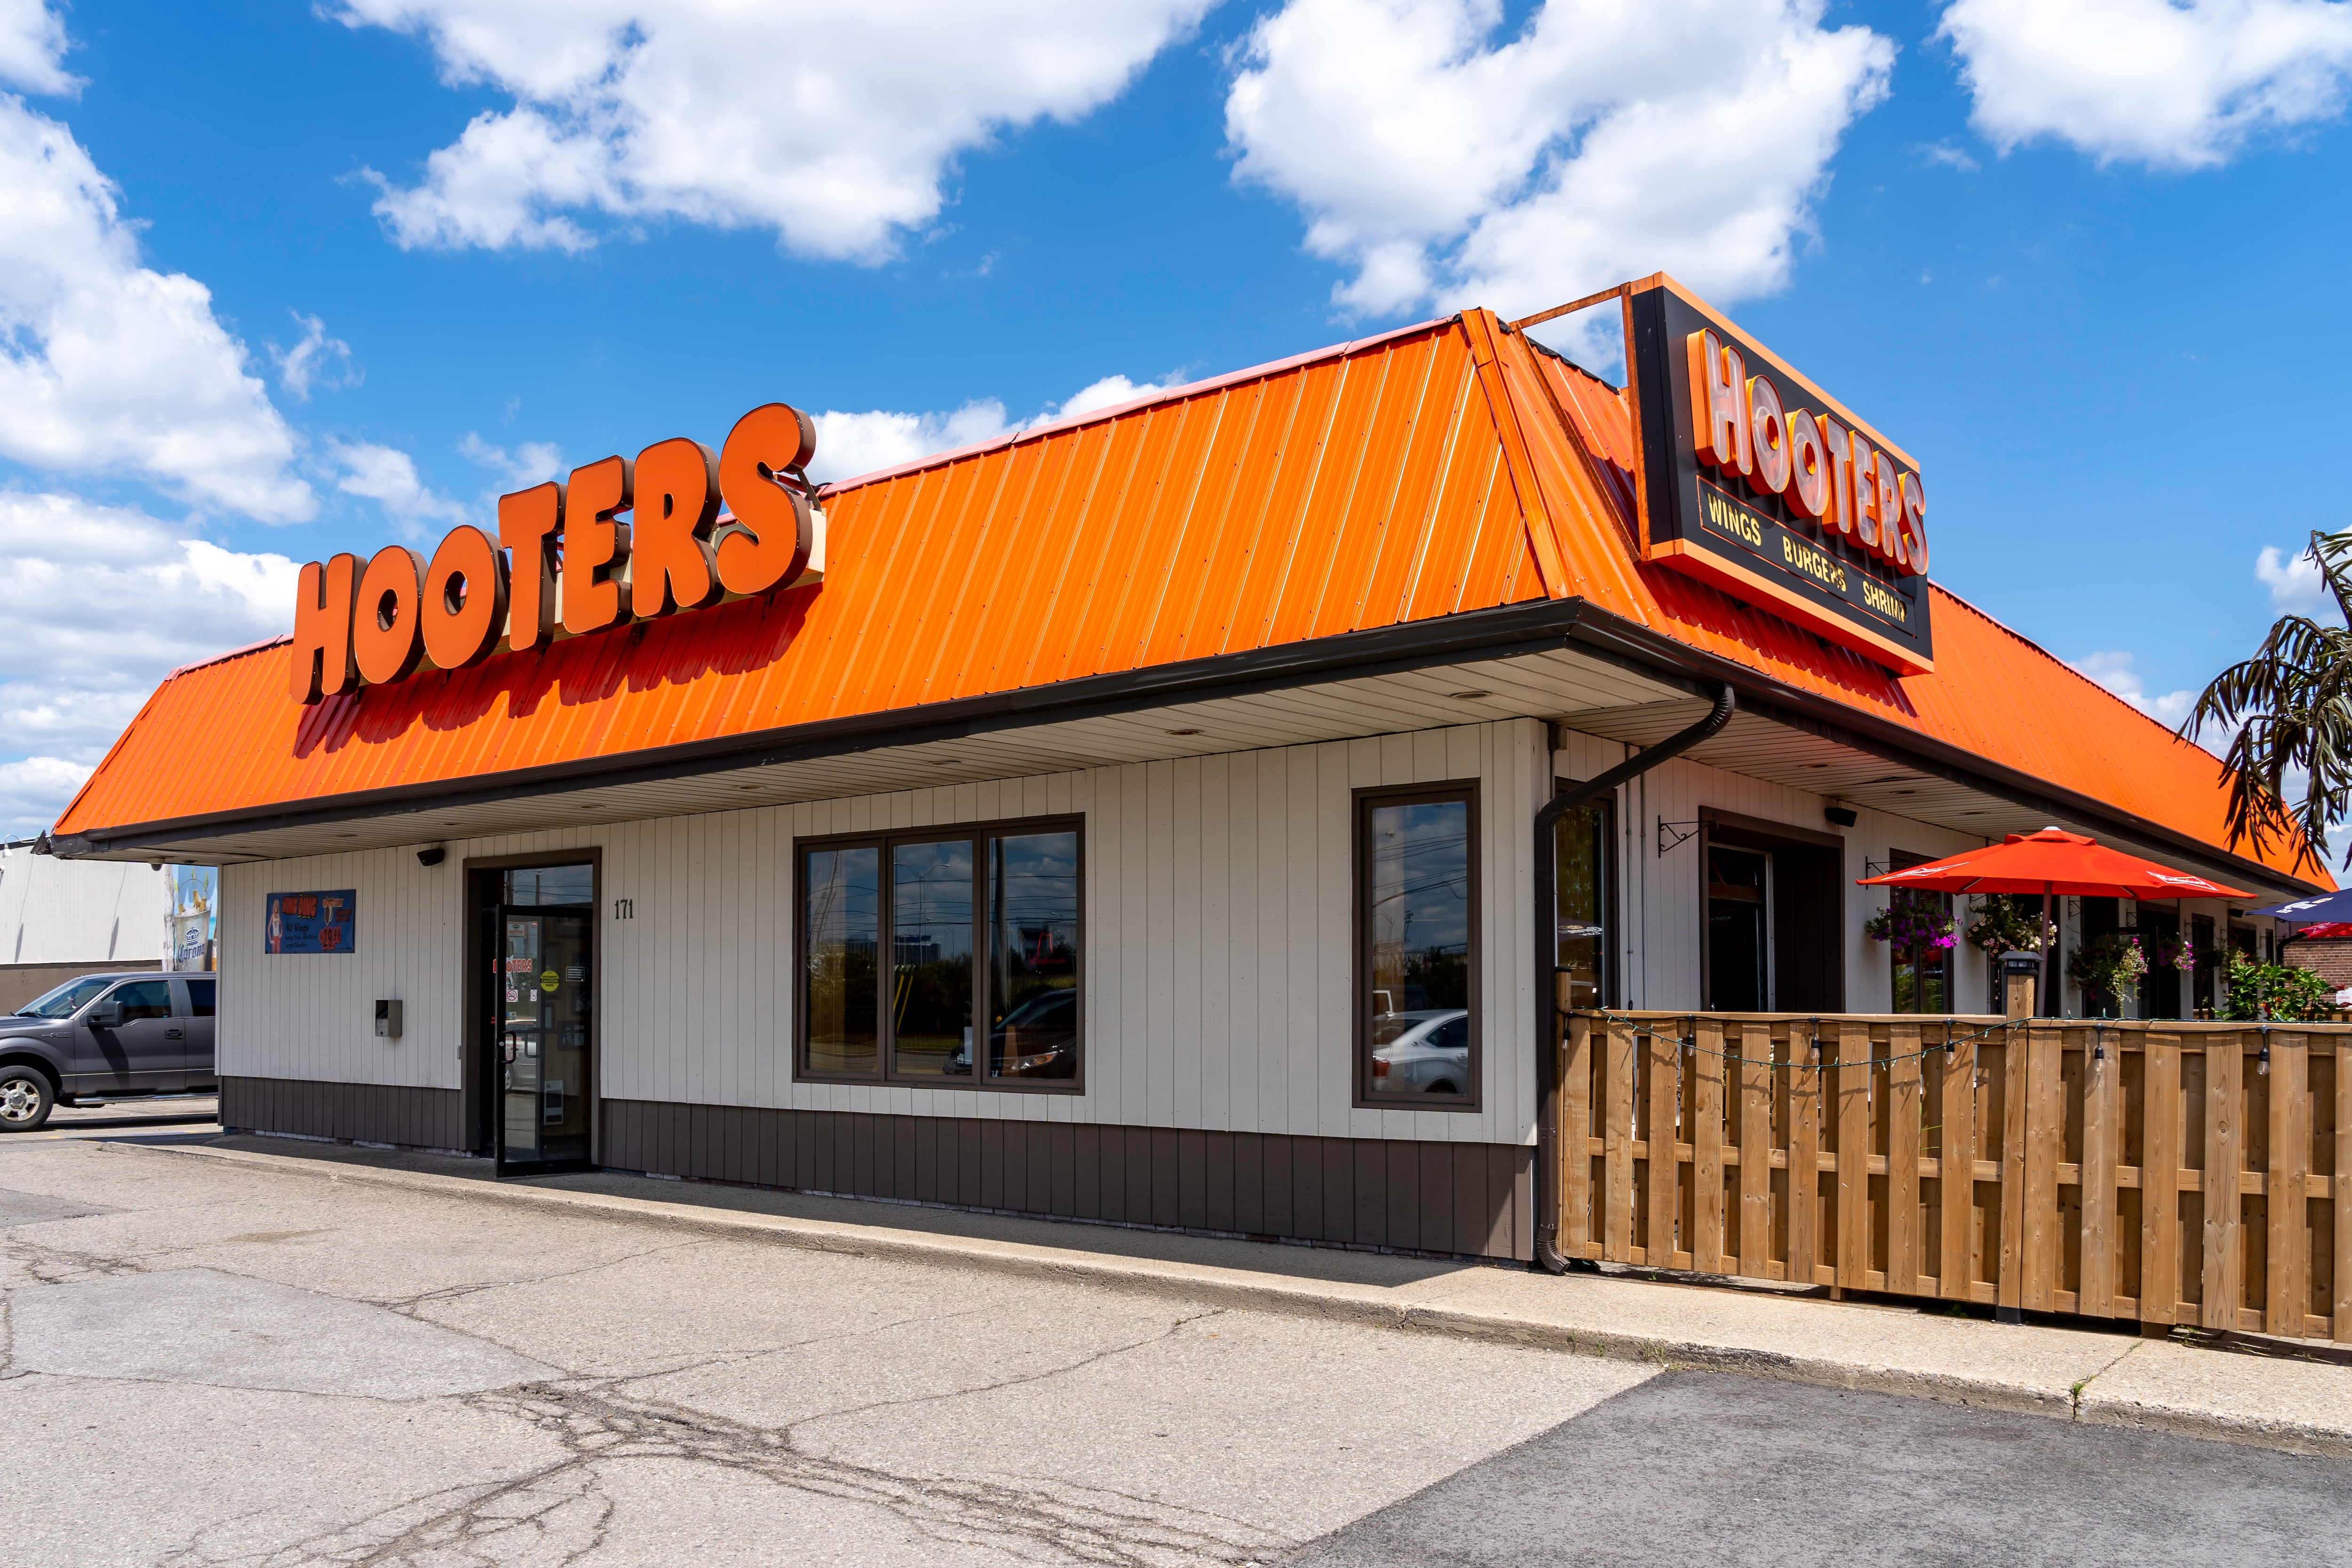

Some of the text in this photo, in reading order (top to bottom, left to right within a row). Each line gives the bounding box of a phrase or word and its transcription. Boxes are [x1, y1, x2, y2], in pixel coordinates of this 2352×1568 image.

[1687, 327, 1929, 576] HOOTERS
[289, 402, 816, 705] HOOTERS
[1707, 492, 1907, 623] WINGS BURGERS SHRIMP
[614, 899, 634, 920] 171
[286, 922, 310, 935] 40 Wings
[320, 927, 341, 949] $29.99
[178, 943, 205, 963] Corona
[493, 958, 532, 973] OTERS
